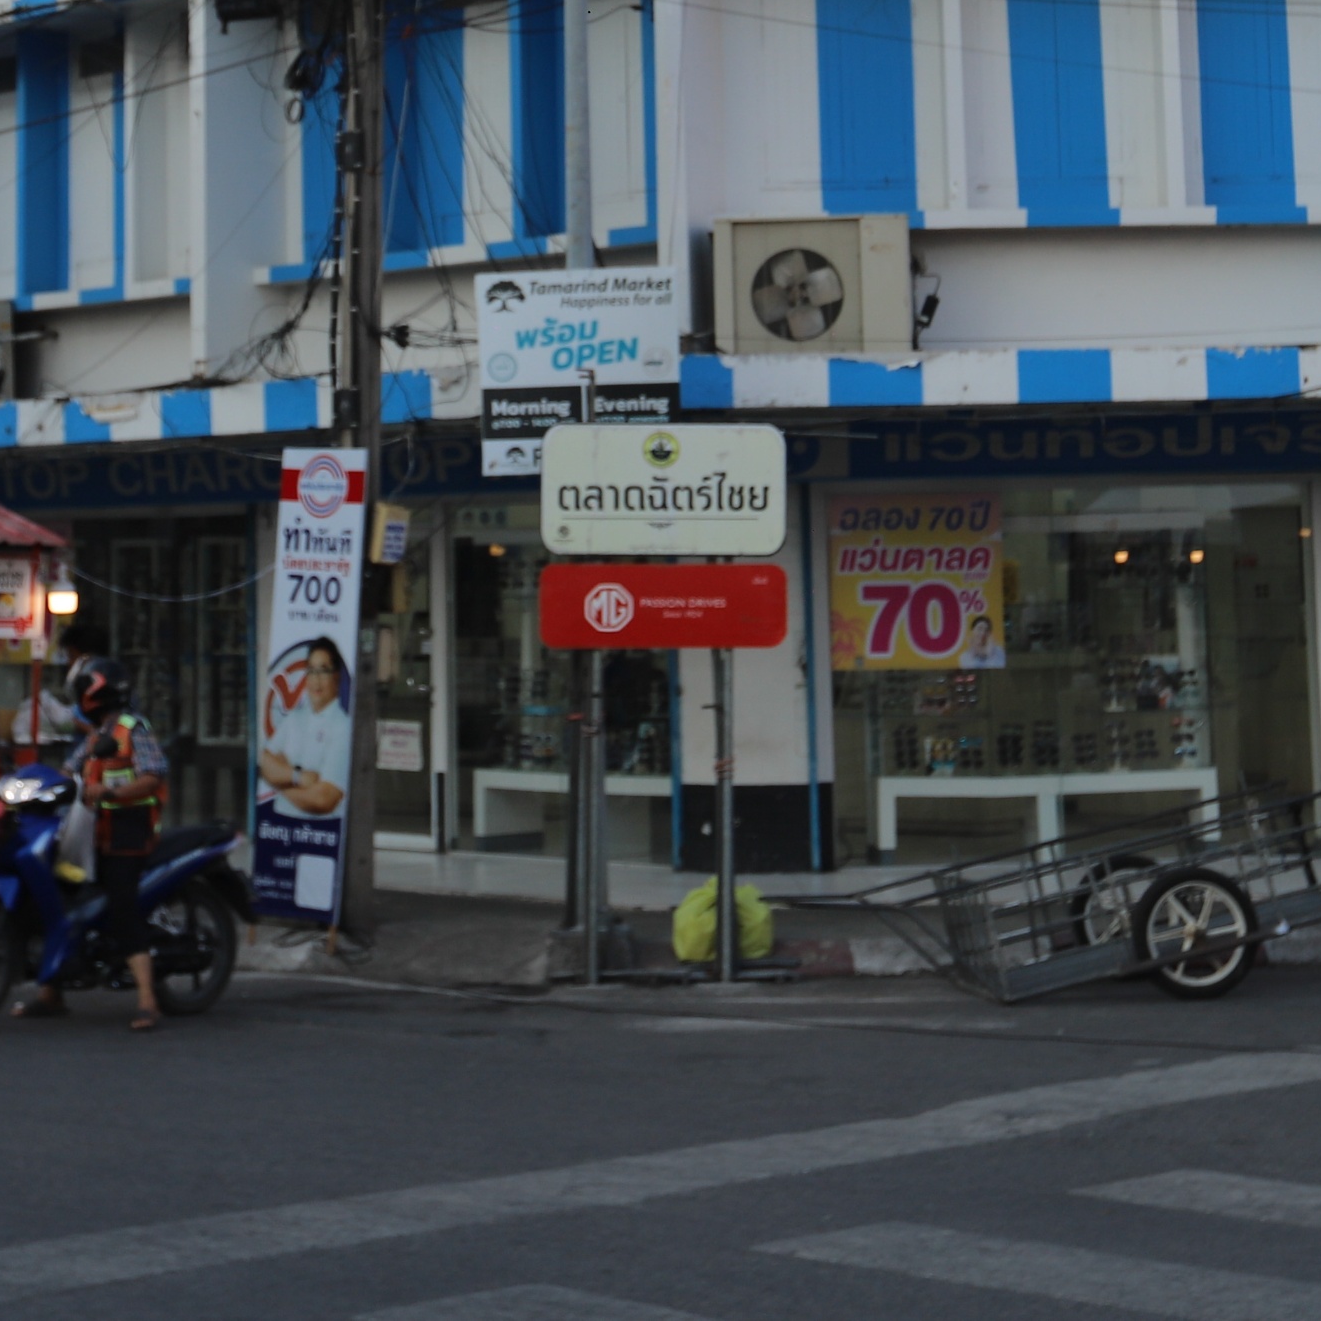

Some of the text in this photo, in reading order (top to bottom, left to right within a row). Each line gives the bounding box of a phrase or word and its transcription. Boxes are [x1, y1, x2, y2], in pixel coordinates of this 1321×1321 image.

[529, 277, 672, 295] Tamarind Market
[560, 293, 672, 309] Happiness for all
[515, 318, 598, 350] พร้อม
[551, 337, 639, 371] OPEN
[490, 398, 572, 417] Morning
[593, 394, 670, 414] Evening
[4, 459, 90, 501] TOP
[108, 450, 282, 497] CHARO
[558, 472, 770, 511] ตลาดฉัตร์ไชย
[839, 500, 991, 531] ฉลอง 70 ปี
[839, 538, 992, 573] แว่นตาลด
[288, 574, 342, 604] 700
[588, 587, 631, 630] MG
